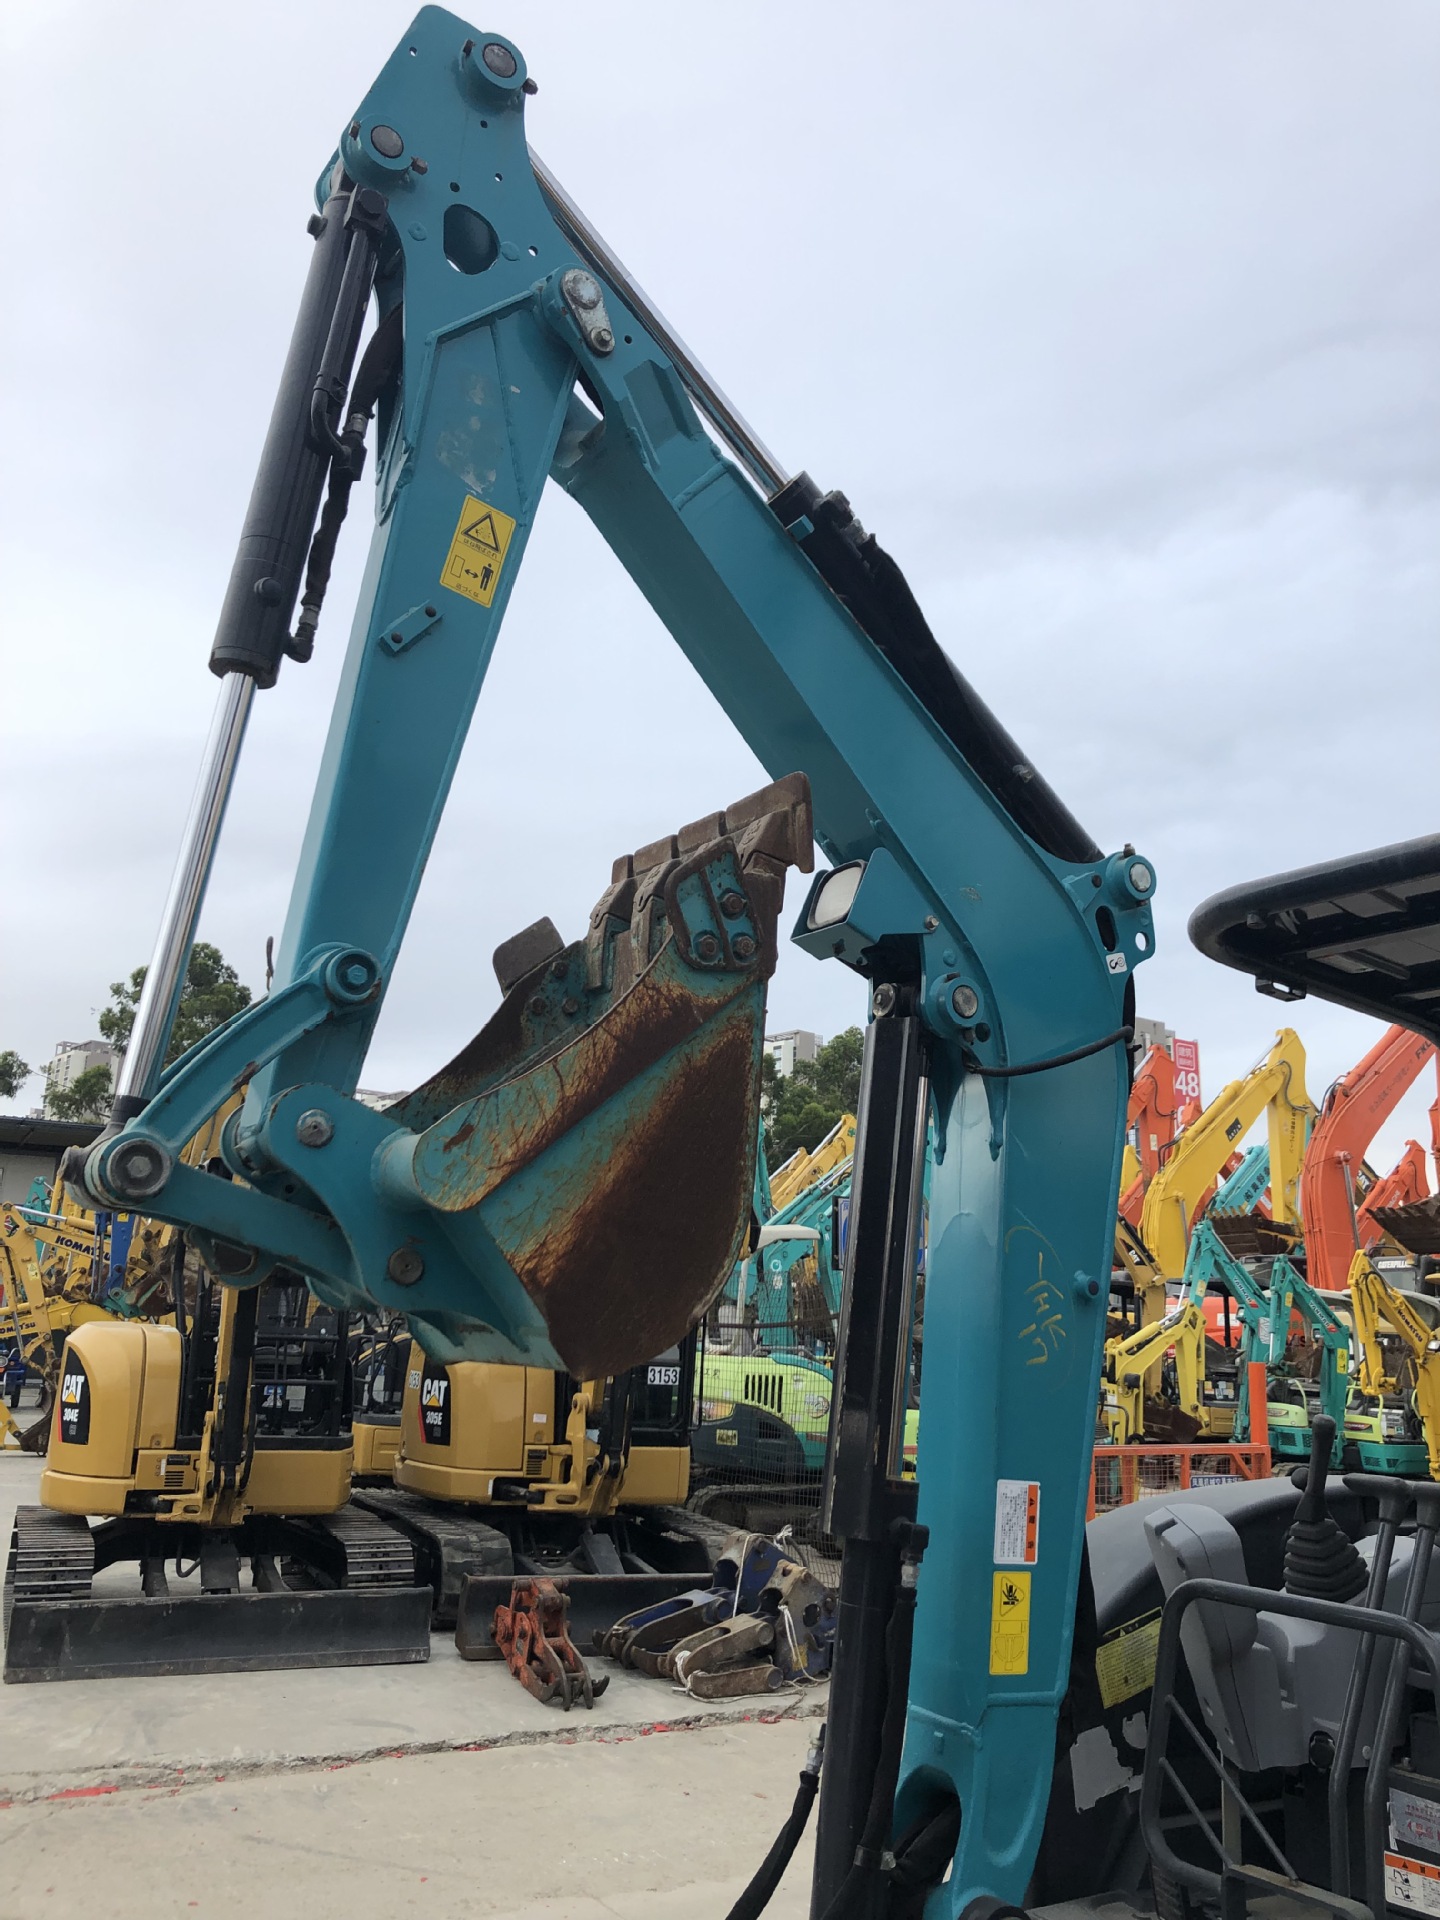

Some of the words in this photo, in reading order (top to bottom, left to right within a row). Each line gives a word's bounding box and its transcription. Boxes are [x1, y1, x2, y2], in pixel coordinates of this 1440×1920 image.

[1175, 1070, 1199, 1097] 48
[1129, 1249, 1140, 1264] CAT
[1397, 1309, 1423, 1342] KOMATSU
[649, 1367, 678, 1384] 3153
[62, 1374, 85, 1404] CAT
[422, 1378, 448, 1408] CAT
[63, 1407, 79, 1423] 304E
[425, 1410, 443, 1426] 305E
